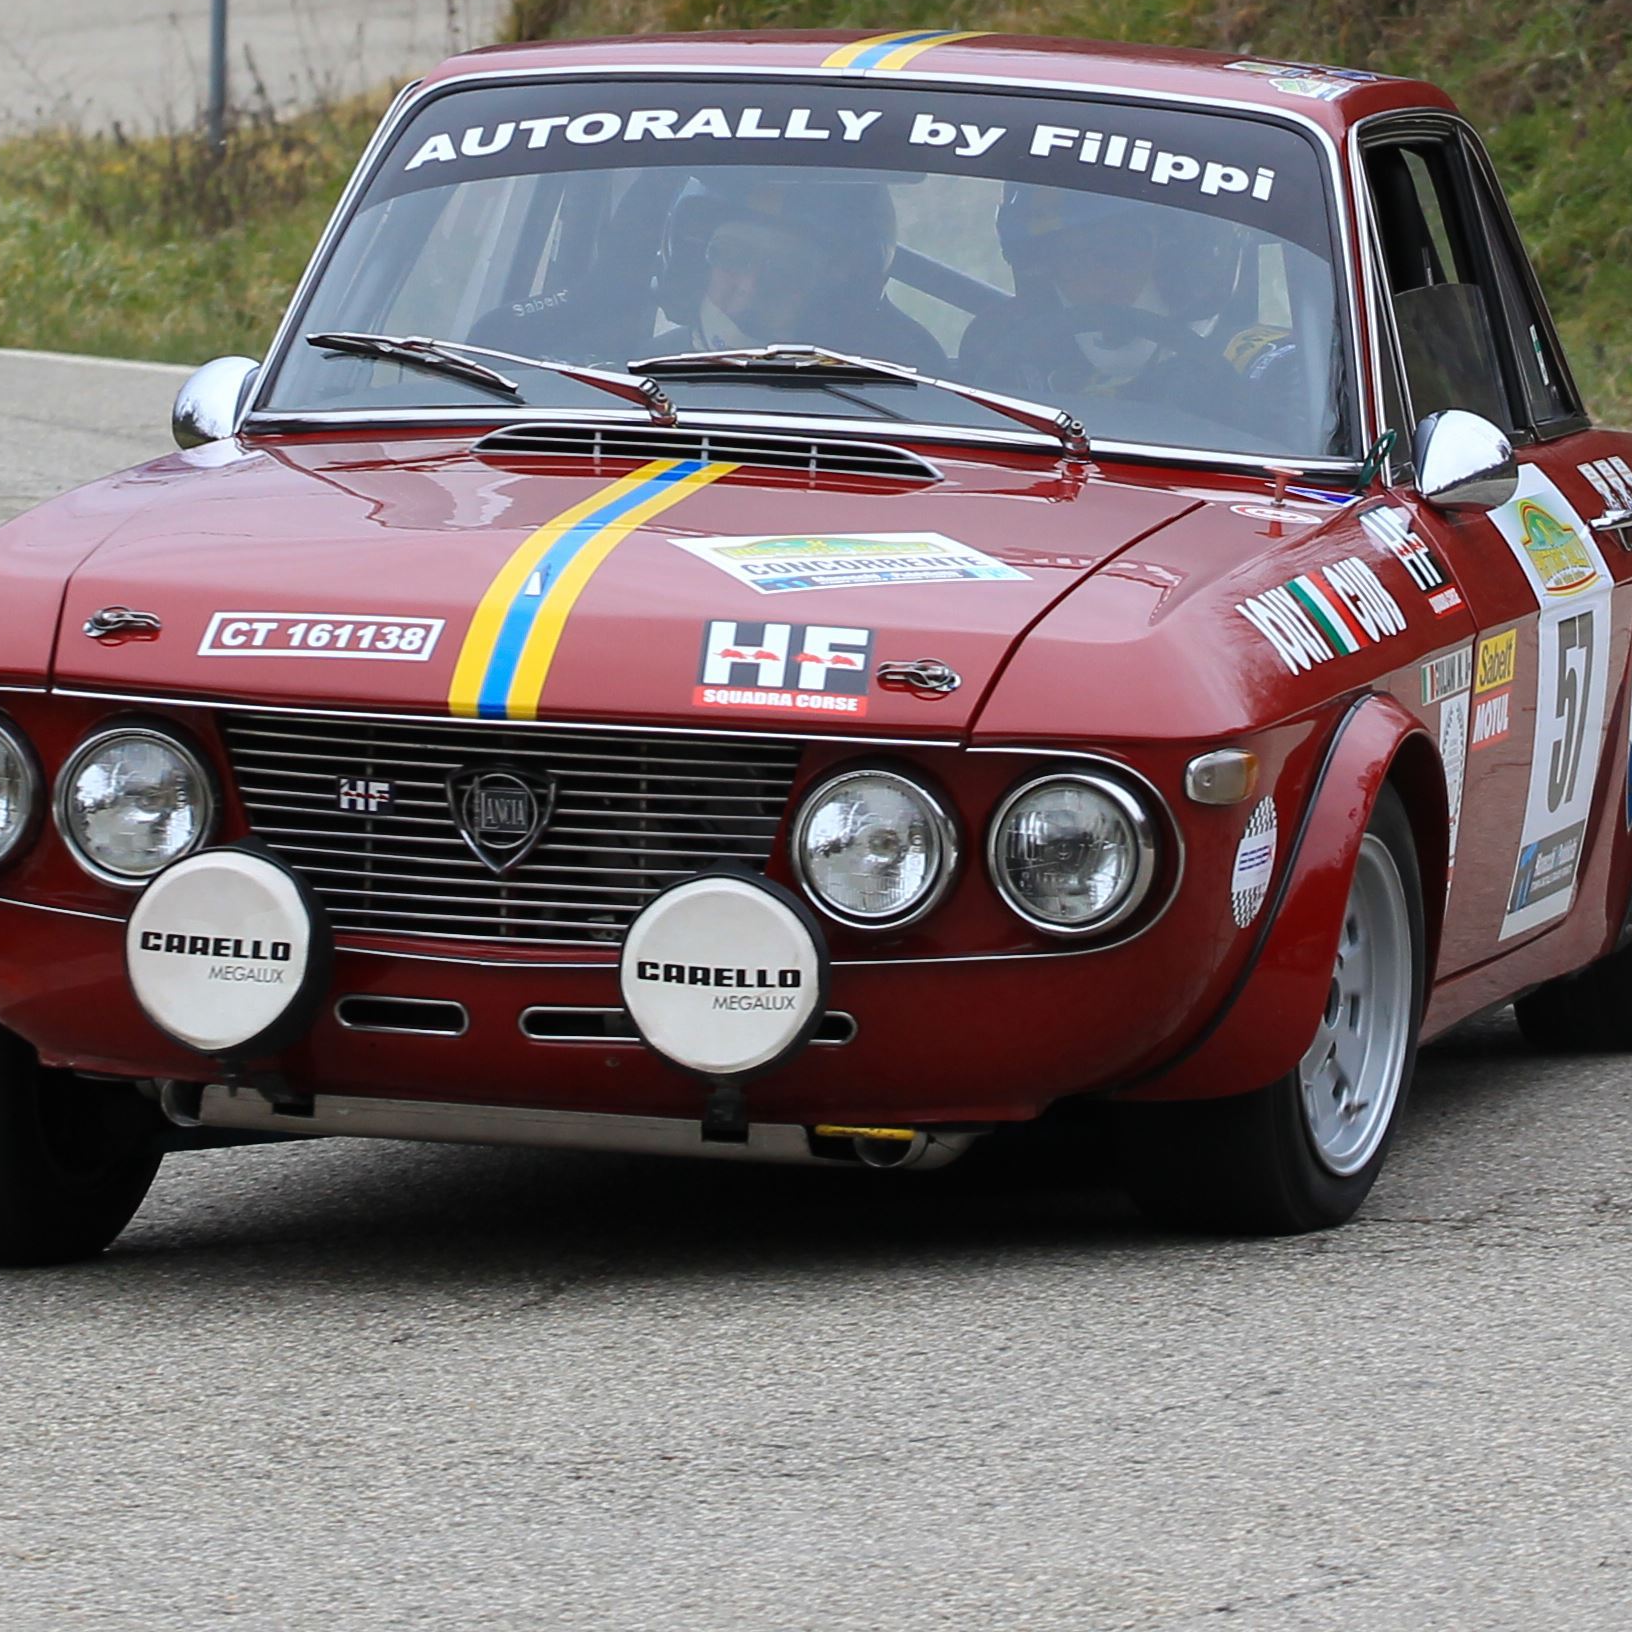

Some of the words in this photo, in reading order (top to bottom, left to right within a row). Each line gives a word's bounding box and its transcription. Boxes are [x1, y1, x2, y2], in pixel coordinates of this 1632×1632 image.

[404, 107, 883, 171] AUTORALLY
[908, 113, 1007, 157] by
[1029, 124, 1277, 202] Filippi
[739, 554, 989, 577] CONCORRENTE
[1321, 557, 1407, 643] CLUB
[220, 621, 279, 646] CT
[286, 622, 427, 651] 161138
[702, 620, 869, 691] HF
[1478, 638, 1514, 688] Sabelt
[702, 689, 793, 708] SQUADRA
[795, 692, 859, 712] CORSE
[1547, 610, 1594, 813] 57
[1471, 692, 1509, 744] MOTUL
[339, 778, 390, 812] HF
[481, 792, 527, 830] LANCIA
[140, 930, 292, 962] CARELLO
[208, 965, 286, 984] MEGALUX
[636, 960, 801, 989] CARELLO
[712, 995, 796, 1011] MEGALUX
